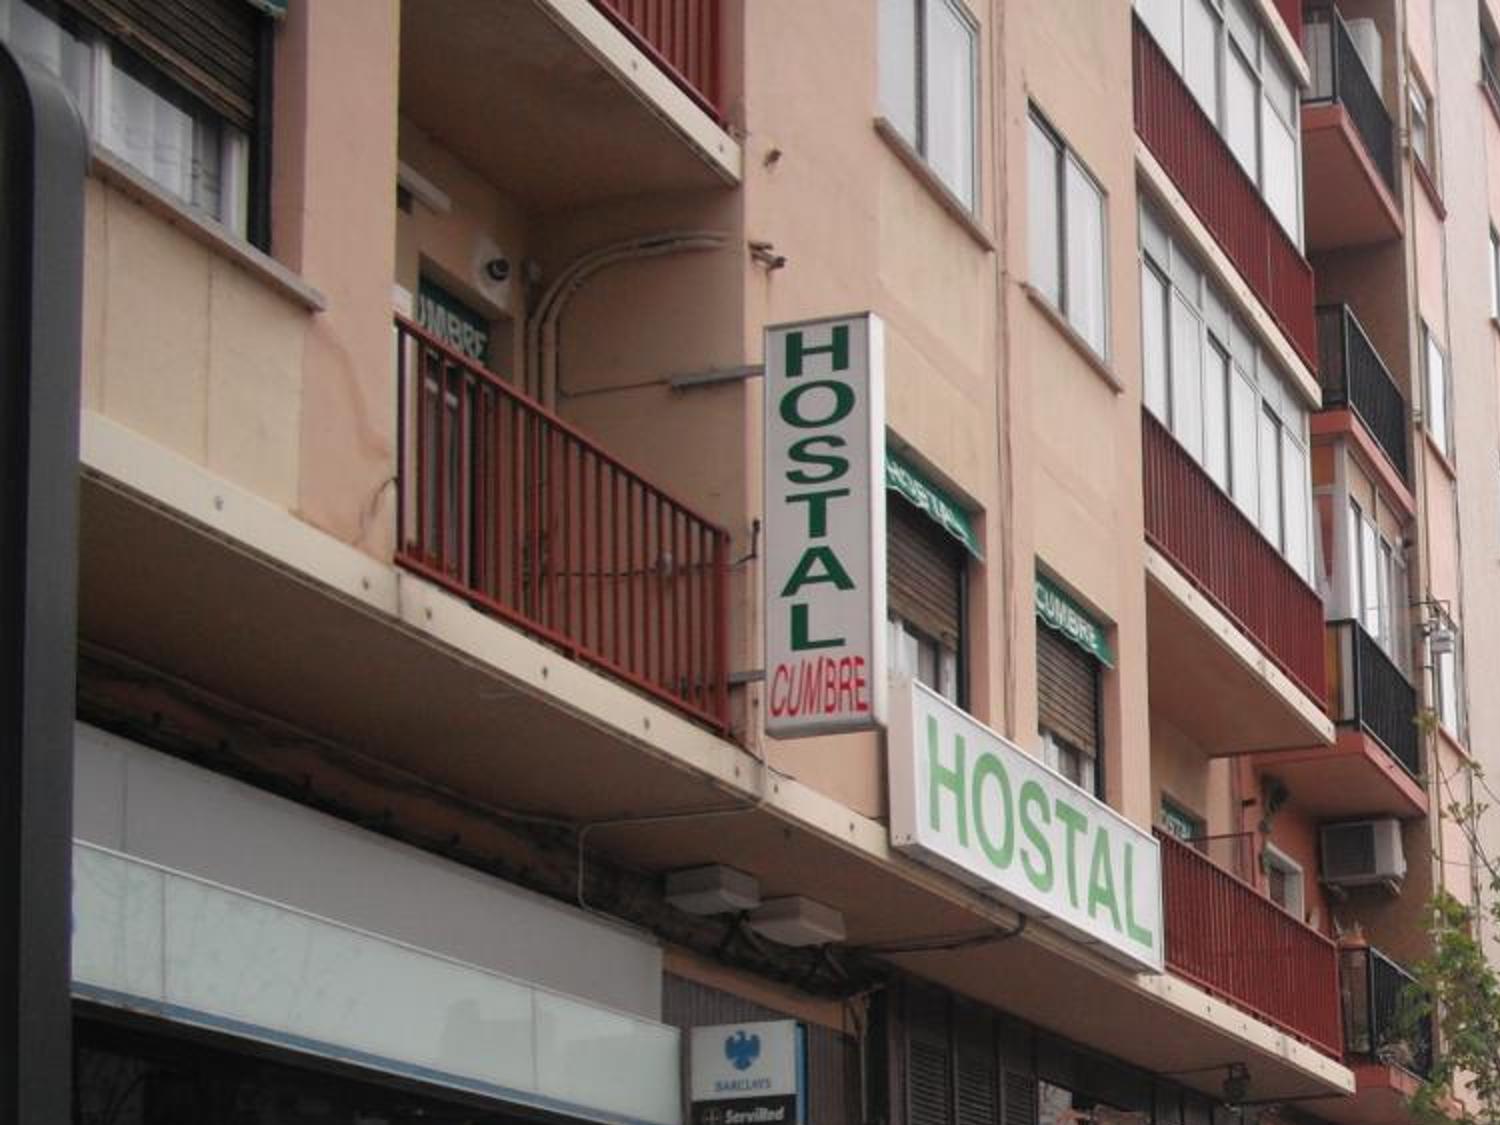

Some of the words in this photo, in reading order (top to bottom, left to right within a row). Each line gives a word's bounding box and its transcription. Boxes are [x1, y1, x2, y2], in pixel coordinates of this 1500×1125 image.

[779, 325, 856, 652] HOSTAL
[1035, 581, 1101, 650] CUMBRE
[769, 656, 870, 717] CUMBRE
[927, 713, 1153, 950] HOSTAL
[715, 1078, 771, 1093] BARCLAYS
[725, 1106, 785, 1125] ServiRed
